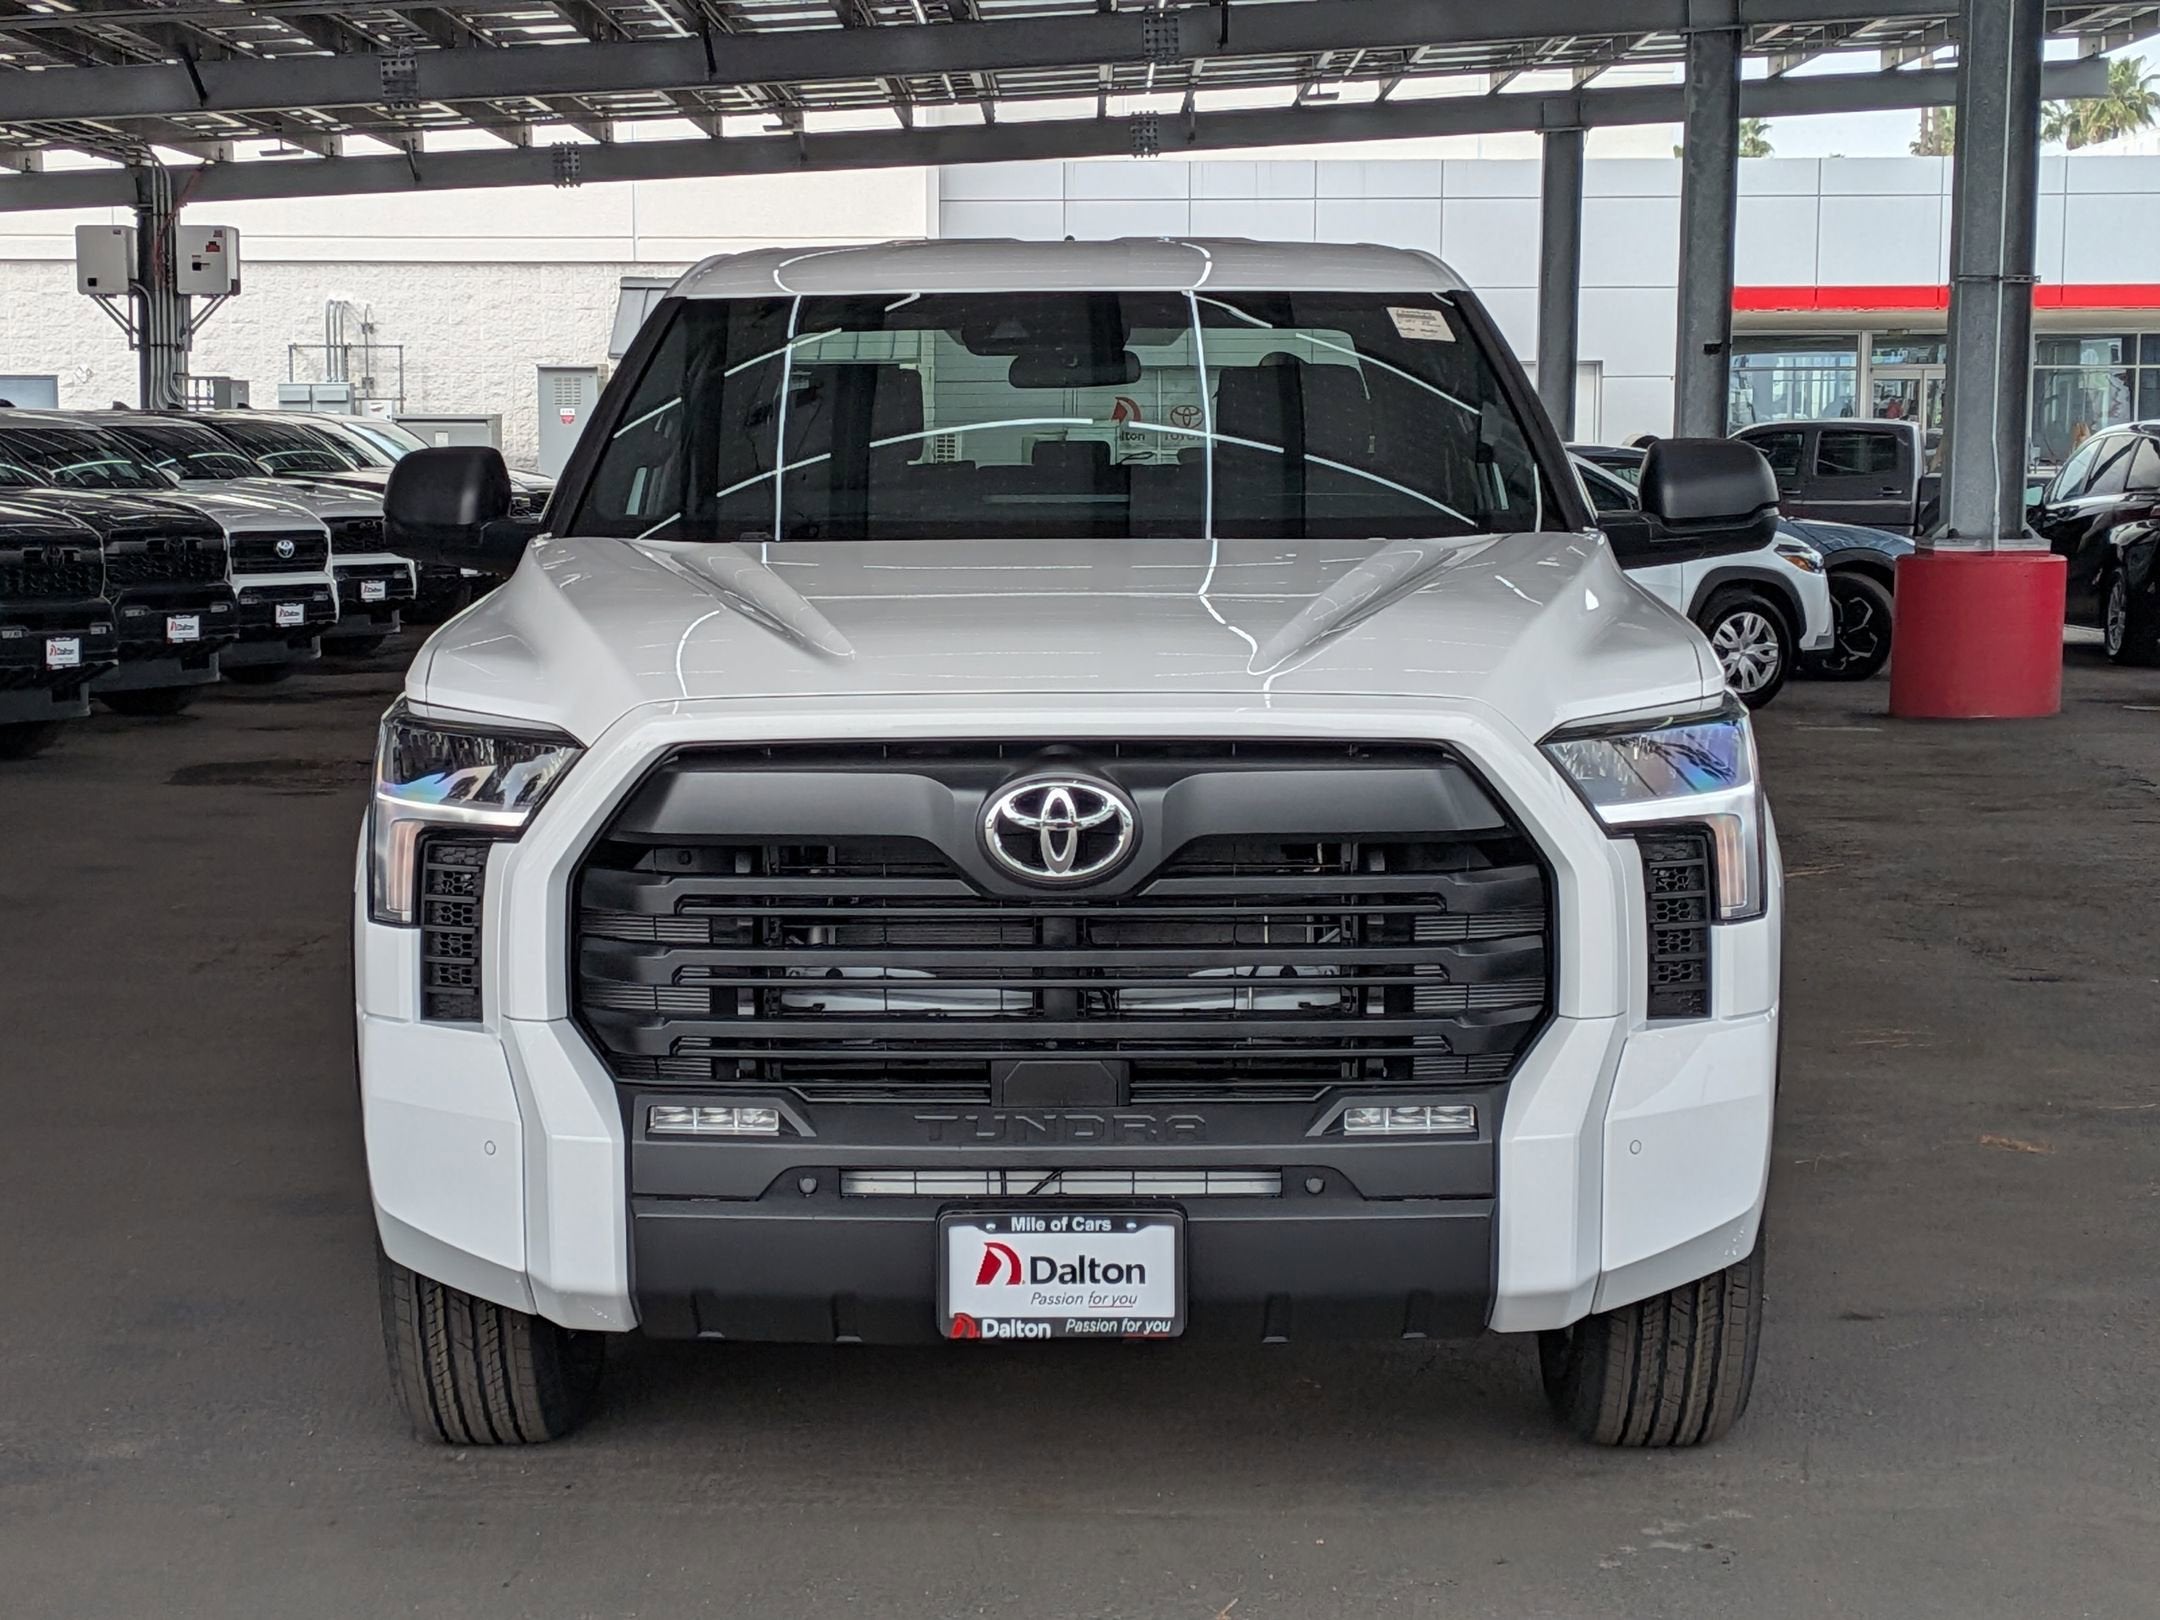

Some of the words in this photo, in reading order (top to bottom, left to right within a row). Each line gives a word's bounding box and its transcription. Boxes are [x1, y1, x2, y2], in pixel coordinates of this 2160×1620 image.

[914, 1114, 1207, 1142] TUNDRA
[1011, 1216, 1046, 1232] Mile
[1050, 1216, 1068, 1232] of
[1072, 1217, 1112, 1232] Cars
[1030, 1254, 1146, 1285] Dalton
[1030, 1291, 1084, 1306] Passion
[1087, 1290, 1109, 1308] for
[1111, 1294, 1138, 1308] you
[982, 1318, 1051, 1338] Dalton
[1065, 1317, 1118, 1334] Passion
[1120, 1317, 1141, 1334] for
[1144, 1321, 1171, 1336] you
